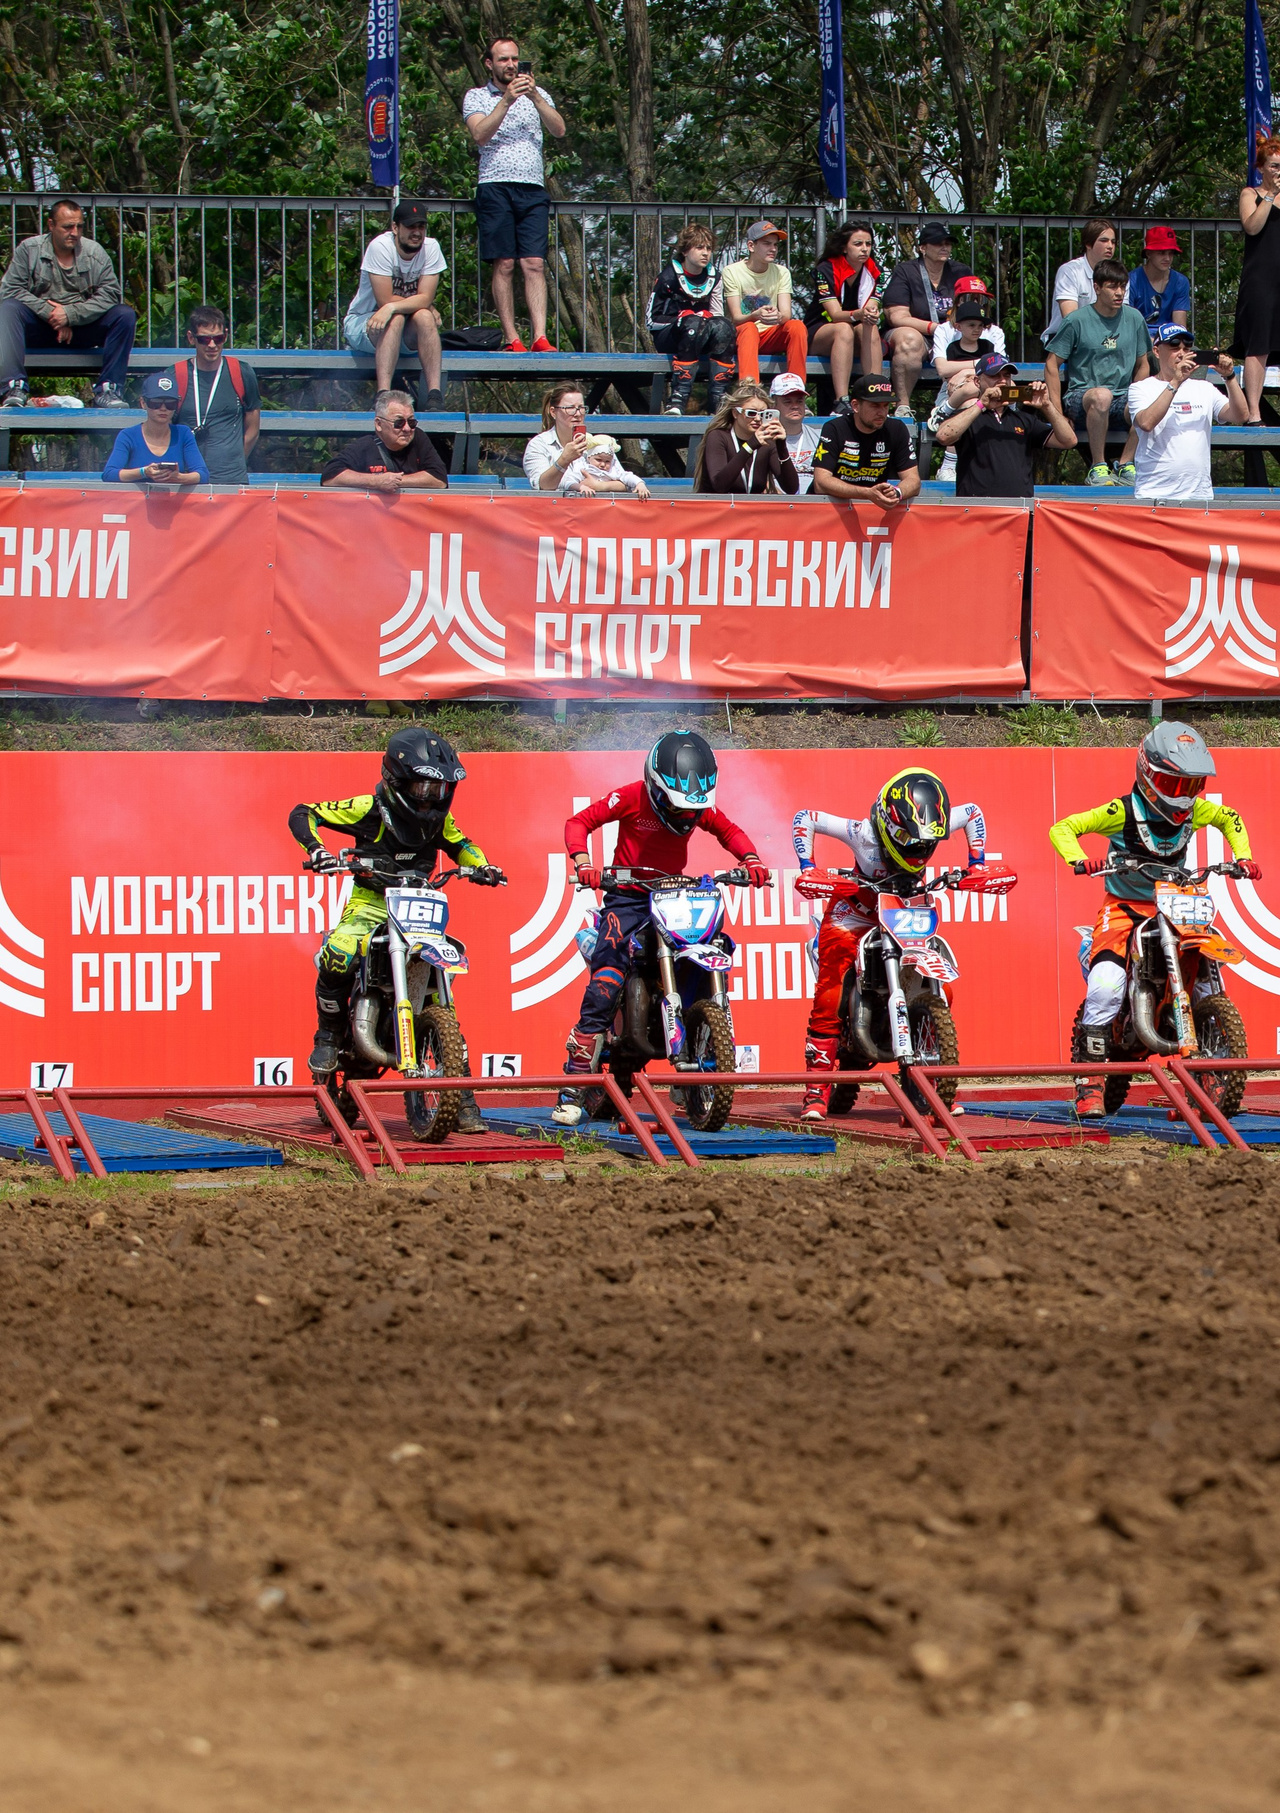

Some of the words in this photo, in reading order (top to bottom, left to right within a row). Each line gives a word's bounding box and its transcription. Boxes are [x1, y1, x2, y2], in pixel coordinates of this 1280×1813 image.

[536, 526, 892, 609] МОСКОВСКИЙ
[534, 612, 702, 681] СПОРТ
[396, 901, 444, 924] 161
[893, 910, 932, 934] 25
[72, 951, 221, 1012] СПОРТ
[35, 1063, 68, 1088] 17
[256, 1060, 287, 1086] 16
[487, 1055, 516, 1077] 15
